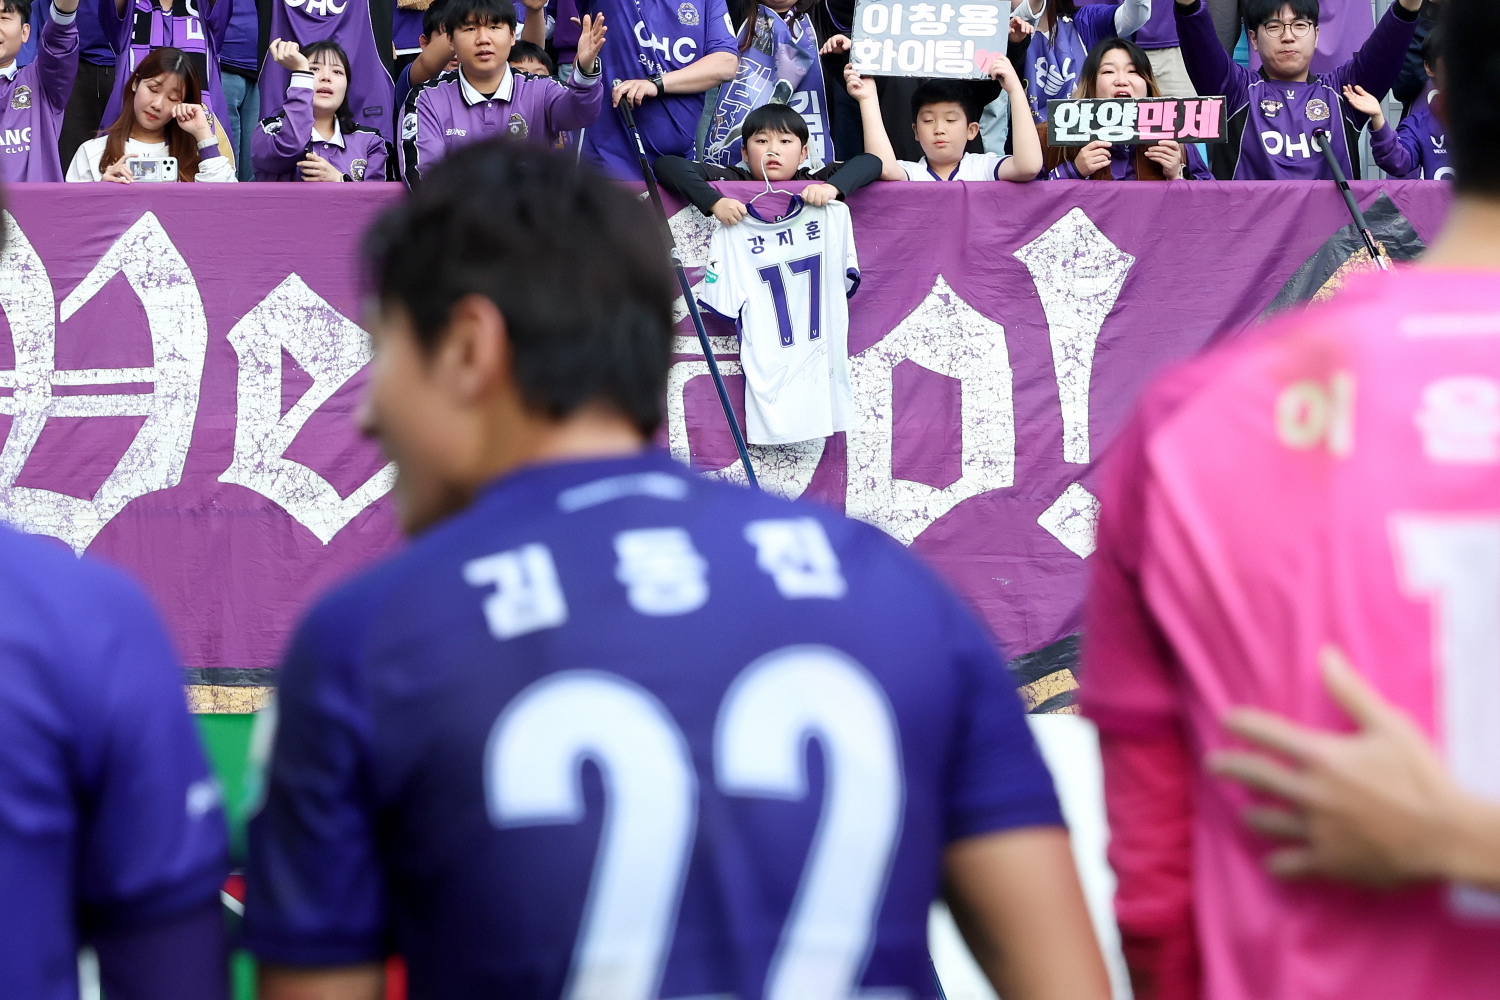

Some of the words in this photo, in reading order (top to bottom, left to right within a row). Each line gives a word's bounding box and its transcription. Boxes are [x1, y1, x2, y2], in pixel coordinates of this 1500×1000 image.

[862, 3, 999, 37] 이창용
[854, 39, 975, 73] 화이팅
[747, 220, 820, 255] 강지훈
[757, 252, 822, 348] 17
[464, 517, 847, 638] 김동진
[484, 643, 905, 1000] 22
